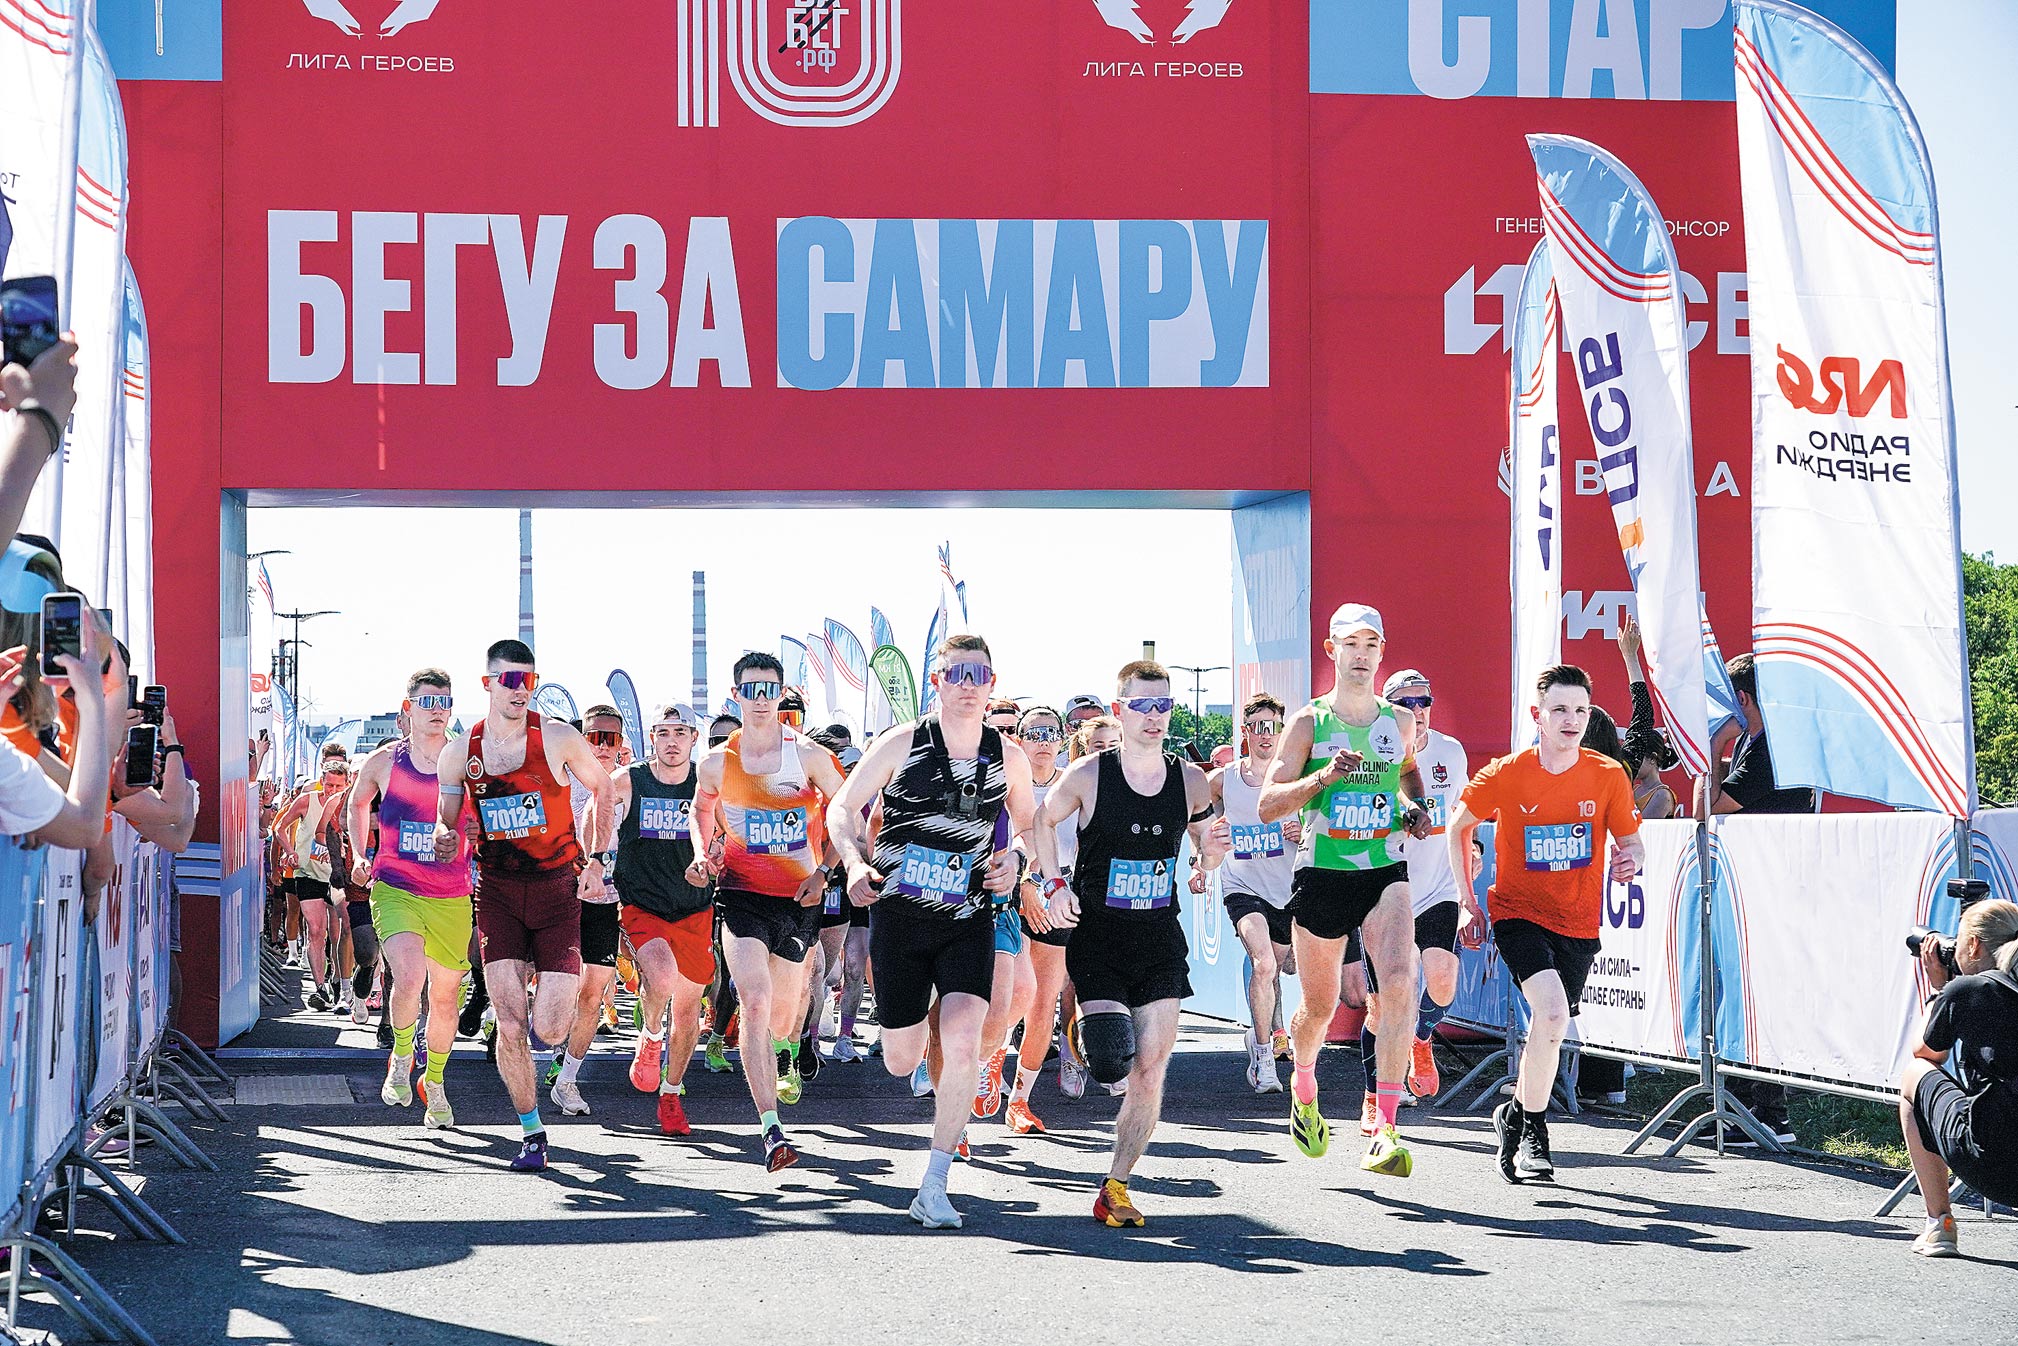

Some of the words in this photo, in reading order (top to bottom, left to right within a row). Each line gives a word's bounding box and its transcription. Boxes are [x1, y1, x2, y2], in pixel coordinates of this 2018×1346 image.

[786, 8, 849, 48] БЕГ
[1408, 0, 1728, 100] СТАР
[286, 53, 351, 69] ЛИГА
[361, 55, 455, 72] ГЕРОЕВ
[1083, 62, 1145, 77] ЛИГА
[1154, 62, 1243, 78] ГЕРОЕВ
[268, 210, 568, 387] БЕГУ
[593, 213, 752, 390] ЗА
[777, 216, 1269, 390] САМАРУ
[1362, 761, 1389, 773] CLINIC
[1343, 773, 1380, 785] SAMARA
[523, 795, 535, 807] A
[680, 801, 690, 812] A
[1375, 795, 1387, 808] A
[1426, 798, 1436, 809] B
[487, 806, 540, 830] 70124
[643, 808, 690, 830] 50322
[785, 812, 797, 824] A
[1334, 805, 1391, 829] 70043
[658, 830, 677, 840] 10KM
[749, 819, 804, 844] 50452
[1572, 825, 1584, 837] C
[402, 832, 434, 852] 505
[767, 843, 788, 854] 10KM
[1235, 832, 1280, 852] 50479
[1530, 835, 1586, 861] 50581
[417, 852, 436, 862] 10KM
[948, 855, 961, 869] A
[1251, 850, 1267, 860] 10KM
[1154, 860, 1166, 875] A
[1548, 860, 1571, 872] 10KM
[904, 858, 967, 893] 50392
[1113, 872, 1169, 898] 50319
[920, 887, 944, 903] 10KM
[1130, 898, 1153, 910] 10KM
[1607, 957, 1632, 978] СИЛА
[1609, 988, 1646, 1010] СТРАНЫ
